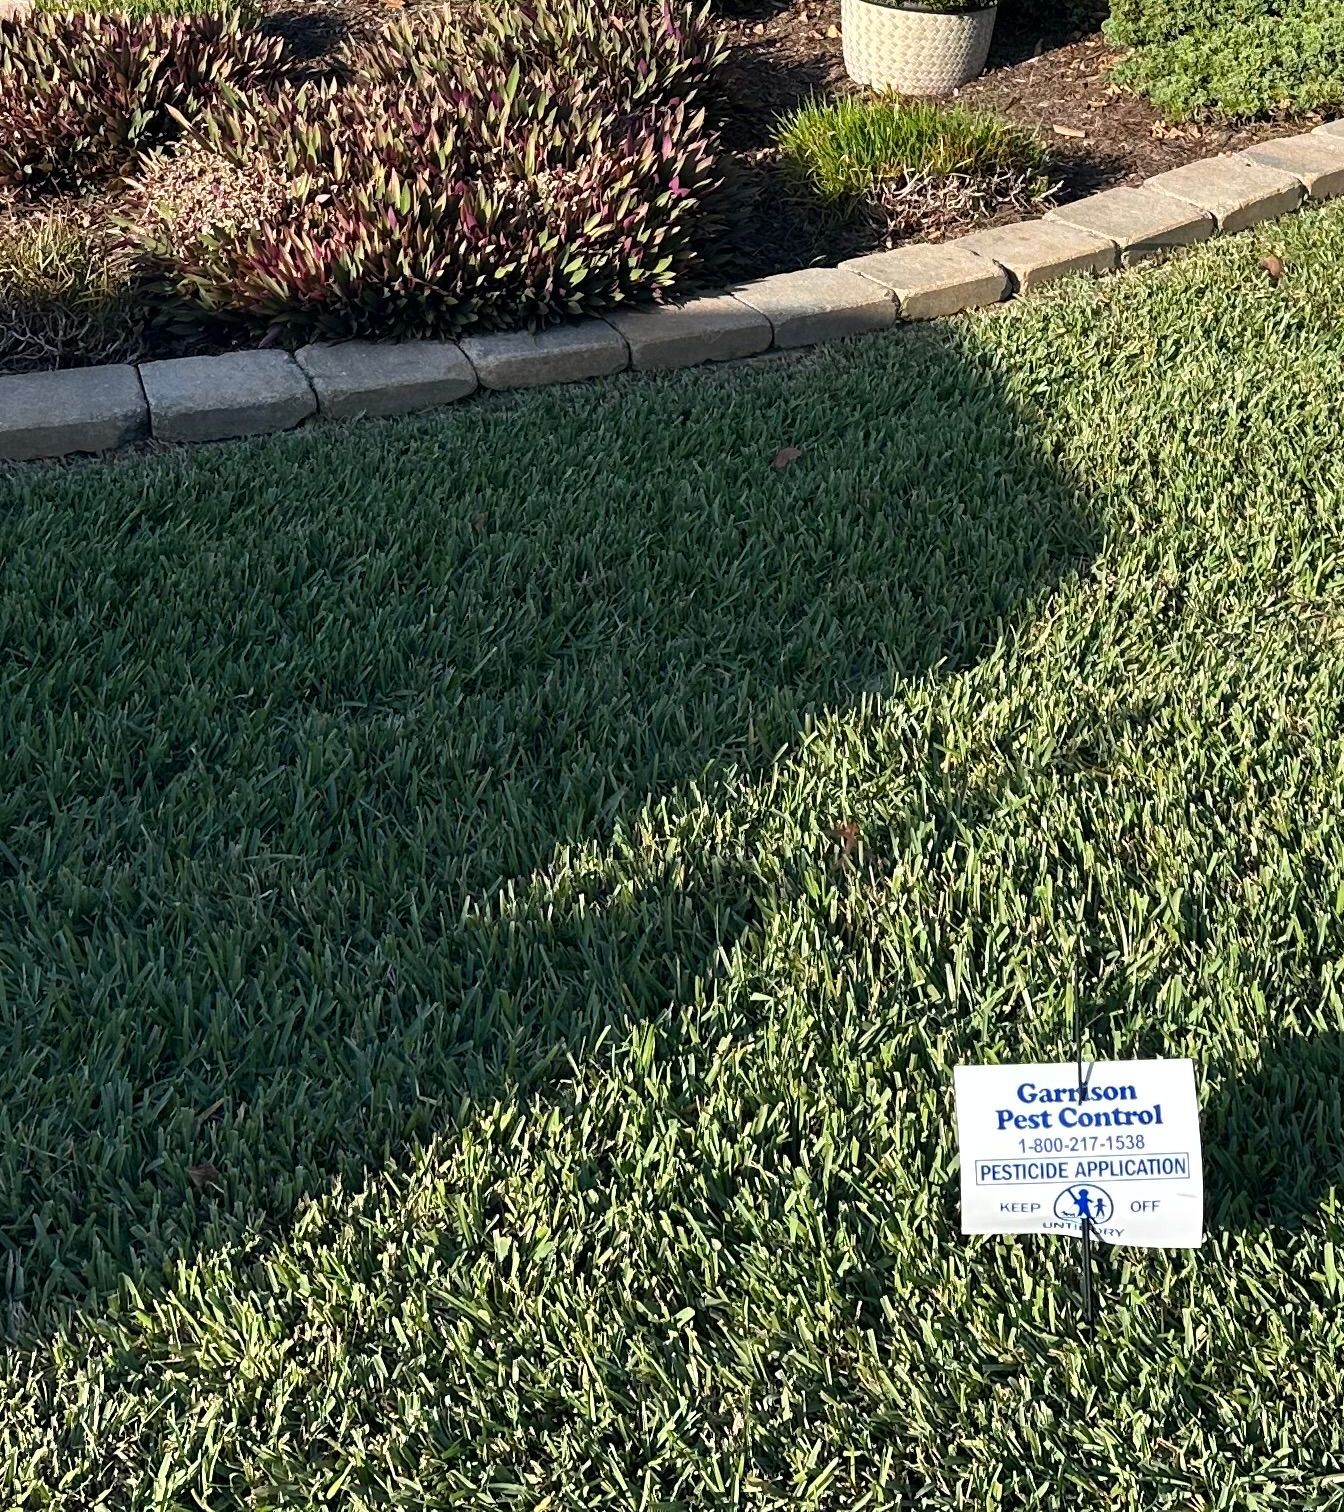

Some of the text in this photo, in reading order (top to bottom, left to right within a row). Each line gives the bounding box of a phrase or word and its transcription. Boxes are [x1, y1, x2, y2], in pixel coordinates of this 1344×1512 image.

[996, 1103, 1163, 1130] Pest Control
[1019, 1134, 1145, 1153] 1-800-217-1538
[981, 1158, 1186, 1181] PESTICIDE APPLICATION
[1000, 1199, 1161, 1213] KEEP OFF
